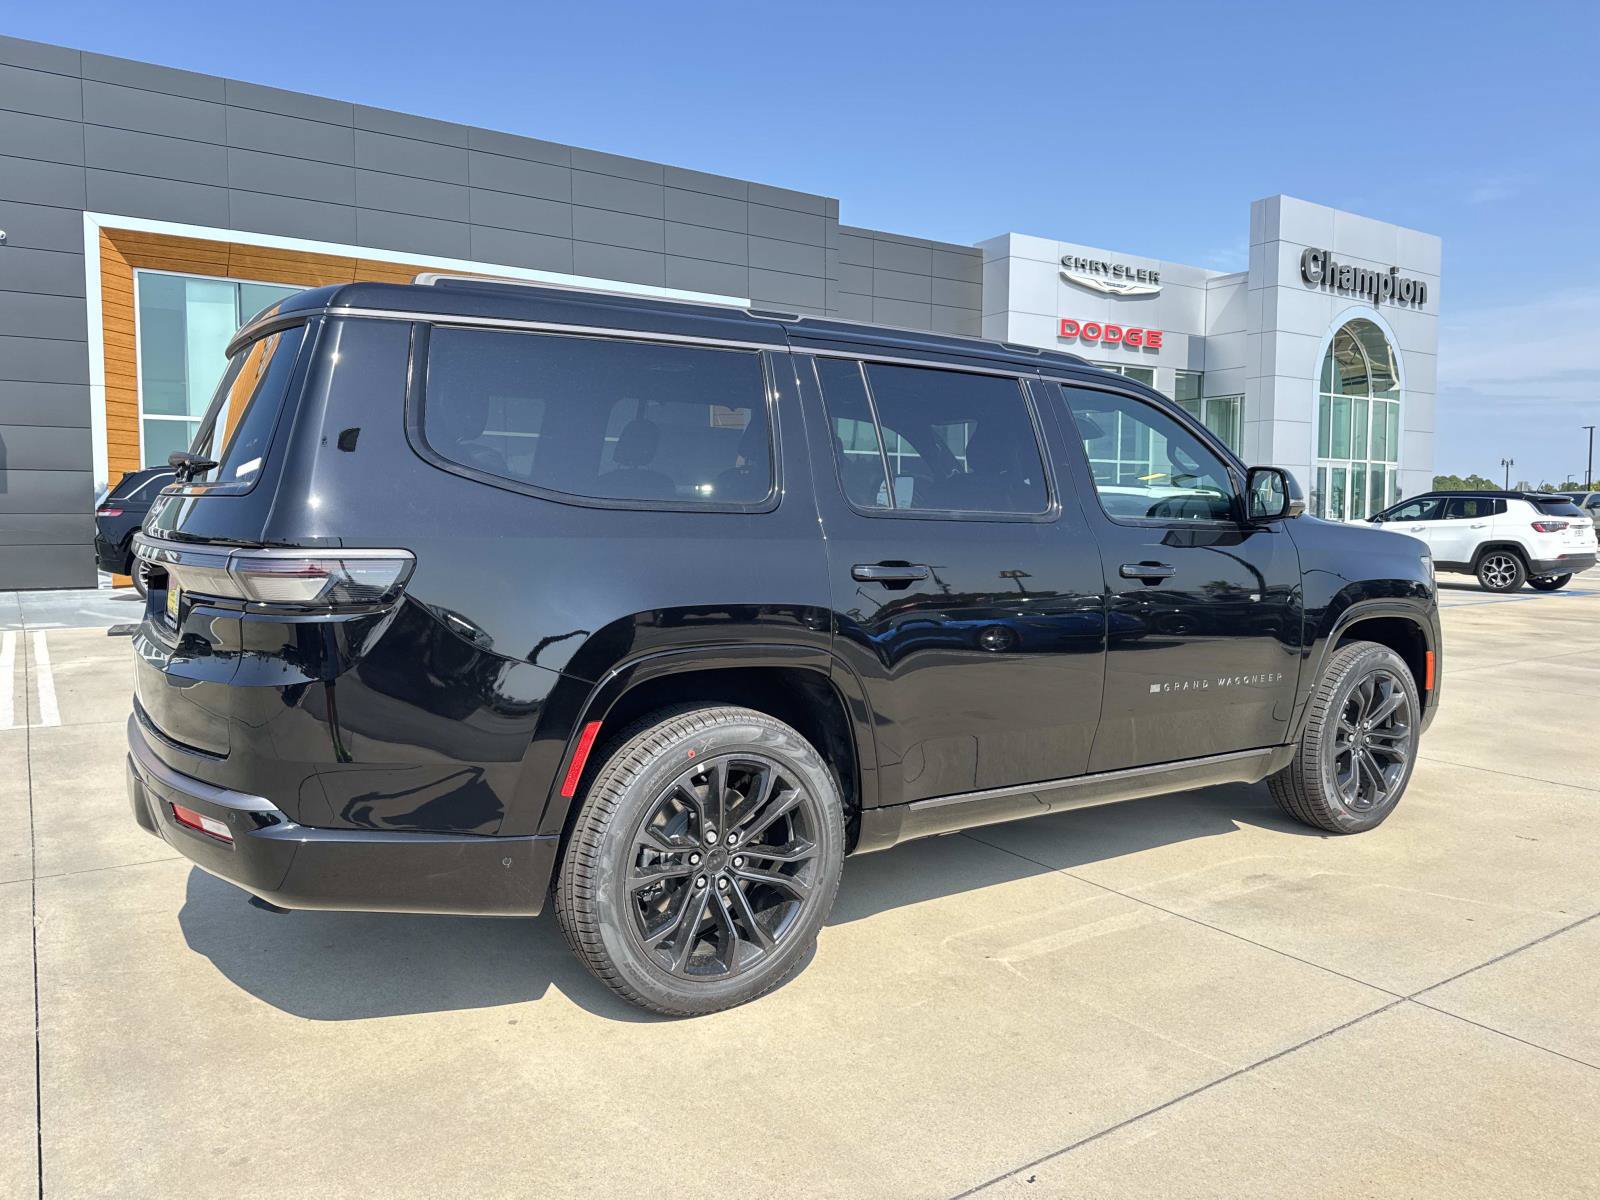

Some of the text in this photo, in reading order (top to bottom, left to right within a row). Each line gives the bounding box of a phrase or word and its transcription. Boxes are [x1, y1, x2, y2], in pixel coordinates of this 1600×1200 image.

[1061, 255, 1160, 283] CHRYSLER
[1301, 247, 1427, 304] Champion
[1060, 319, 1163, 348] DODGE
[1163, 672, 1283, 692] GRAND WAGONEER
